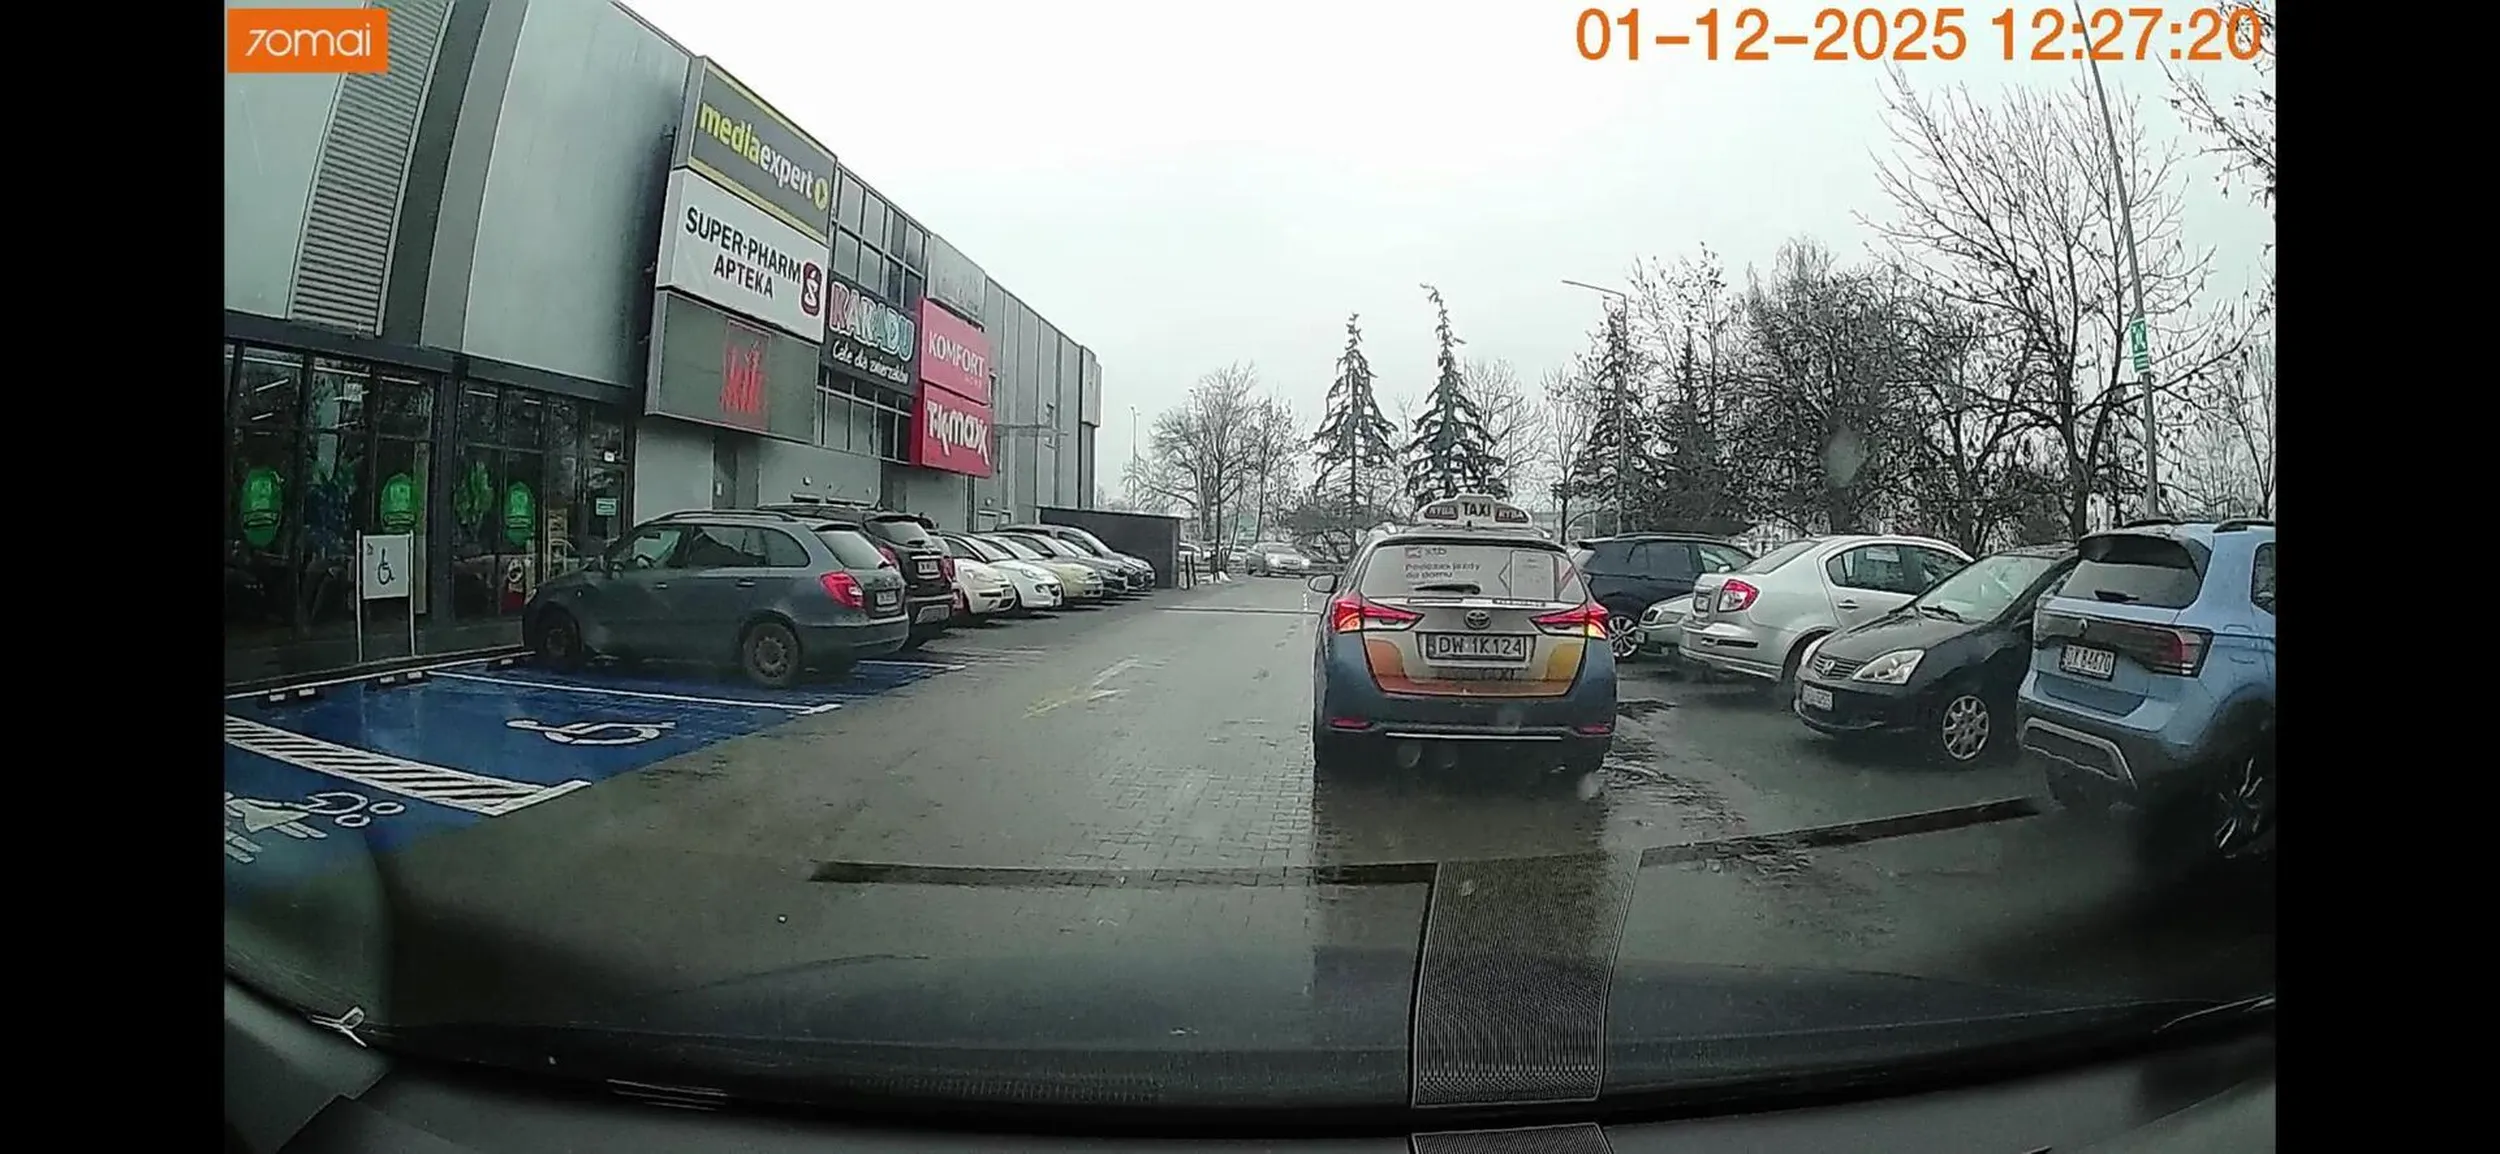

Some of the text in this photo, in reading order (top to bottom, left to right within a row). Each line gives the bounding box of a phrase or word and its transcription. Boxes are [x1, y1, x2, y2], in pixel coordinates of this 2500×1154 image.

[684, 205, 802, 285] SUPER-PHARM
[713, 253, 774, 300] APTEKA
[928, 330, 985, 378] KOMFORT
[1462, 501, 1492, 517] TAXI
[1439, 636, 1522, 656] DW 1K124
